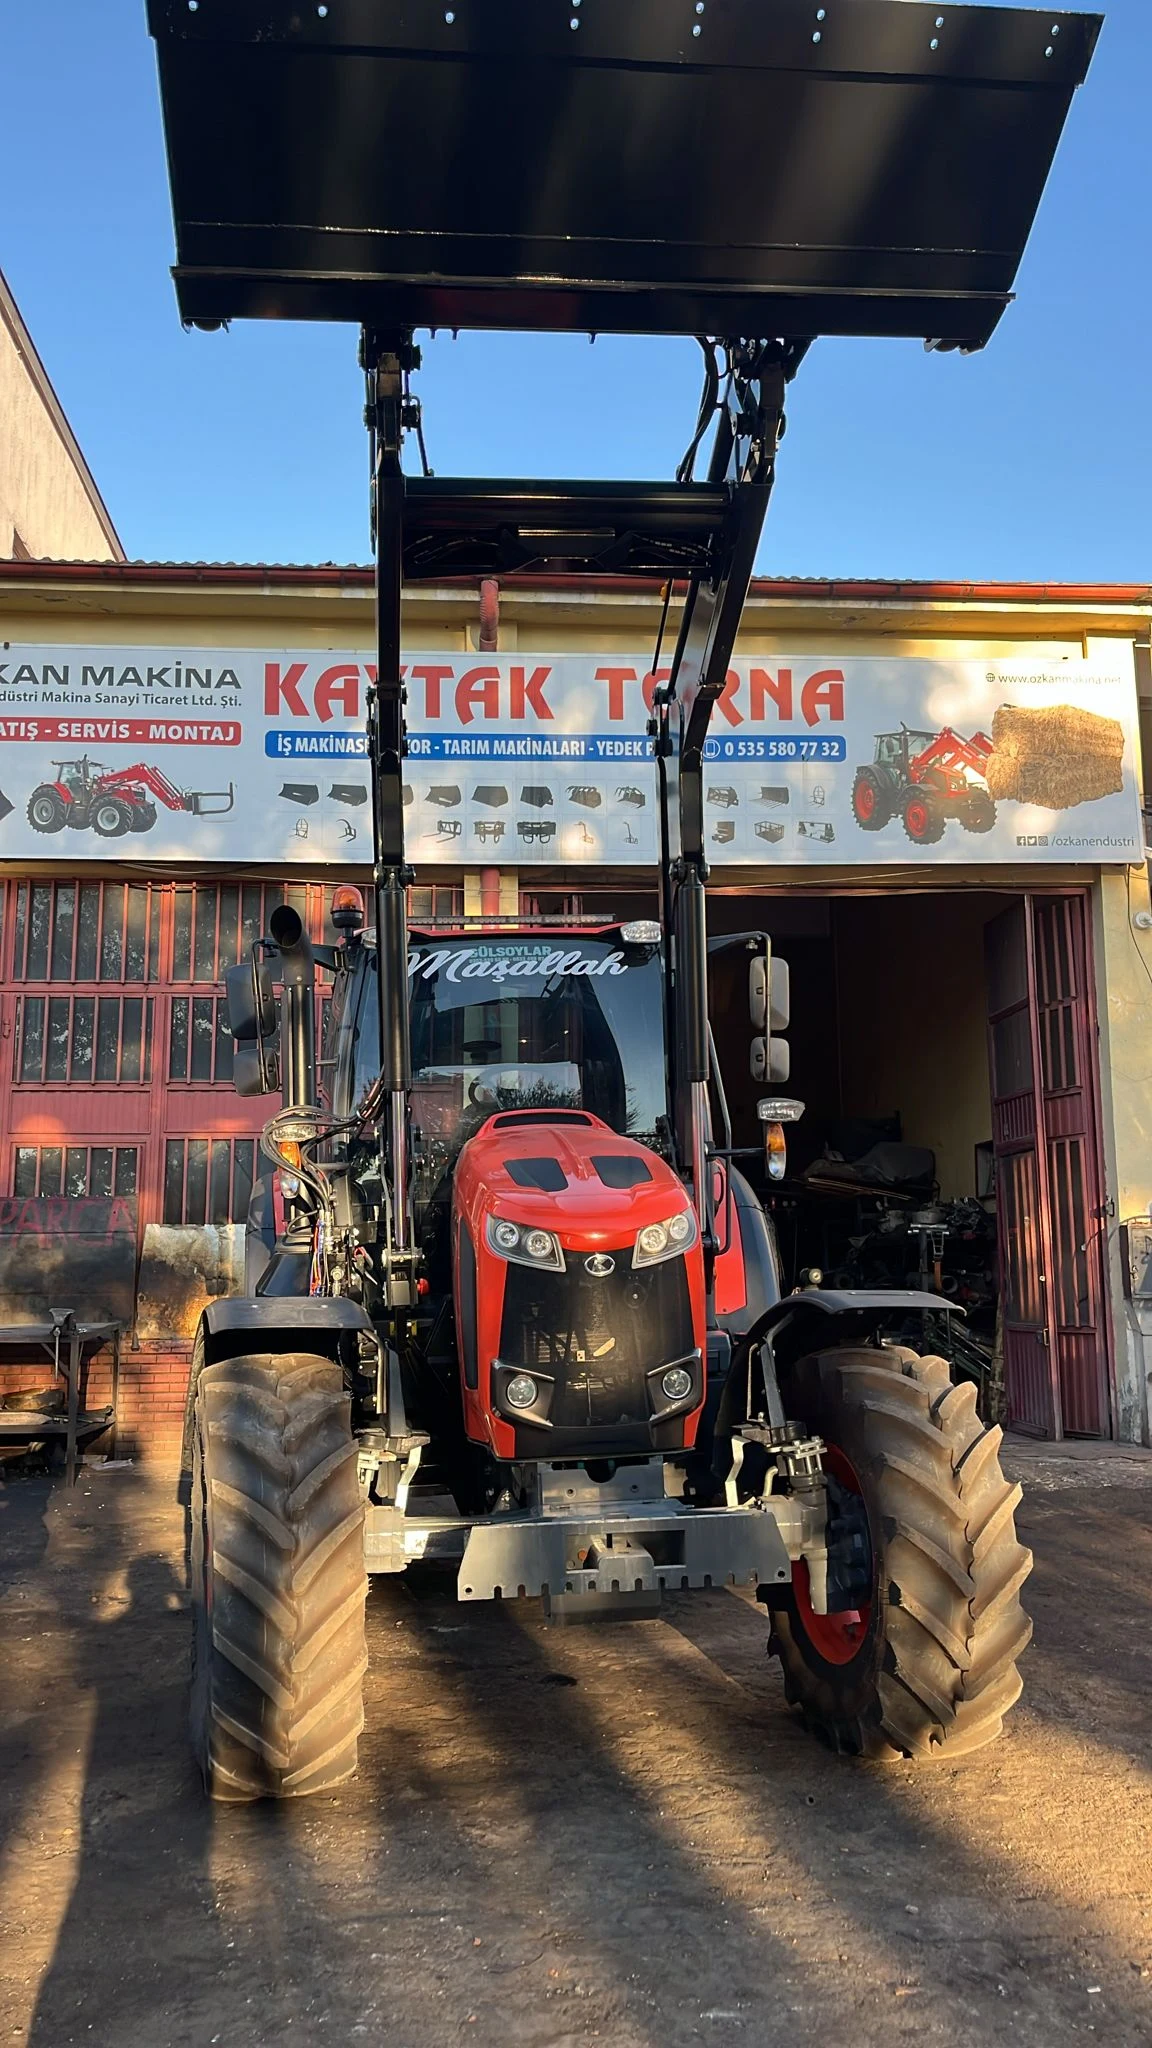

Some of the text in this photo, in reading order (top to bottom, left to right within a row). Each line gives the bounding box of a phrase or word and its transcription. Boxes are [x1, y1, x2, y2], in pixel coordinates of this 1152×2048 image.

[82, 660, 242, 689] MAKİNA
[42, 691, 91, 703] Makina
[95, 692, 140, 706] Sanayi
[142, 693, 188, 705] Ticaret
[192, 694, 217, 706] Ltd.
[220, 695, 242, 709] Şti.
[58, 720, 130, 739] SERVİS
[149, 724, 234, 741] MONTAJ
[277, 733, 292, 756] İŞ
[442, 739, 490, 755] TARIM
[493, 737, 585, 756] MAKİNALARI
[596, 740, 643, 756] YEDEK
[724, 741, 840, 756] 0 535 580 77 32
[1051, 835, 1135, 847] /ozkanendustri
[408, 949, 629, 983] Maşallah
